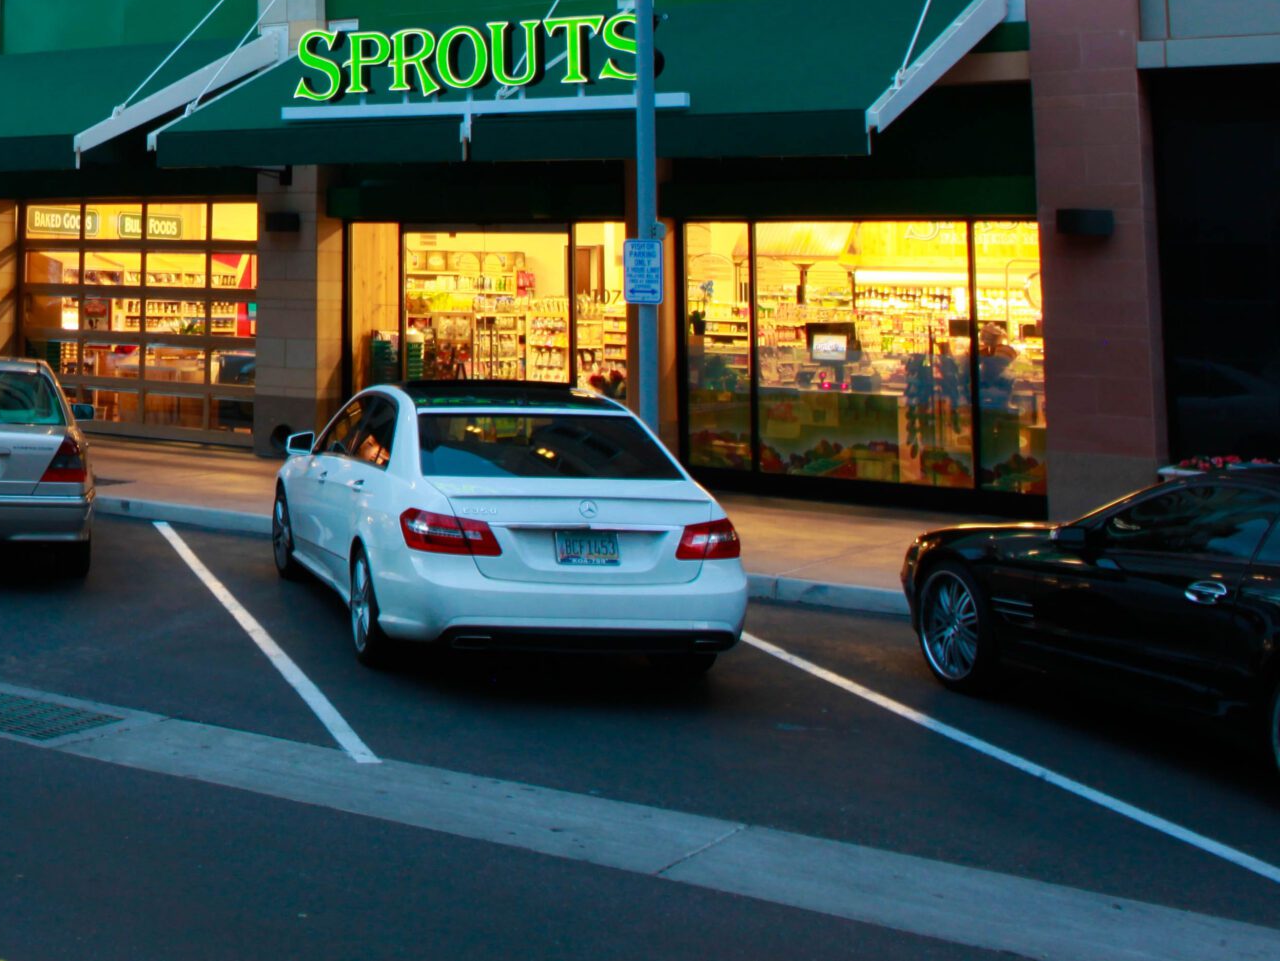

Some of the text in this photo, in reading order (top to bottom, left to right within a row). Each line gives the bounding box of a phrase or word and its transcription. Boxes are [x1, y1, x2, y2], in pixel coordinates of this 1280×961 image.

[293, 13, 638, 101] SPROUTS
[34, 211, 93, 230] BAKED GOOS
[124, 217, 178, 235] BUL FOODS
